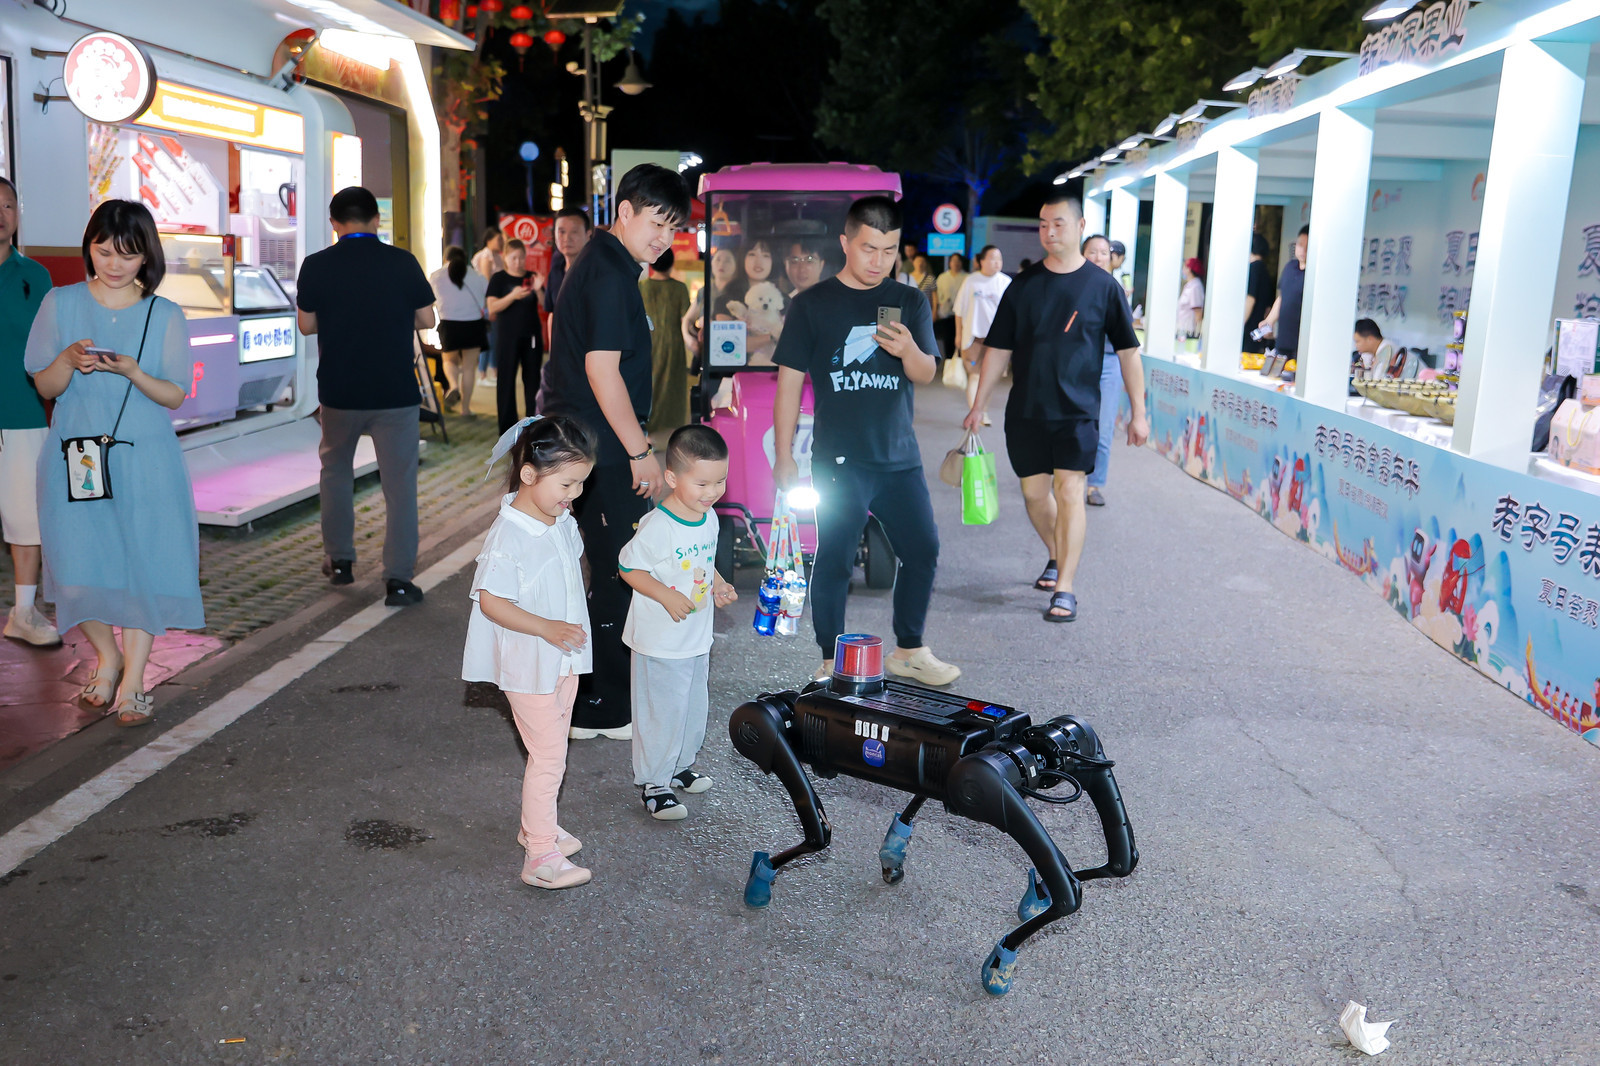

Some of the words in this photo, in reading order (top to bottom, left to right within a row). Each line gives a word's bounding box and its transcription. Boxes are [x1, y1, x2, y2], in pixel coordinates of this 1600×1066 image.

[942, 211, 952, 228] 5
[1361, 234, 1413, 275] 日荟聚
[1356, 283, 1408, 322] 情武汉
[829, 370, 900, 392] FLYAWAY
[1314, 424, 1421, 501] 老字号美食嘉年华
[675, 543, 699, 560] Sing
[1538, 578, 1599, 629] 夏日荟聚
